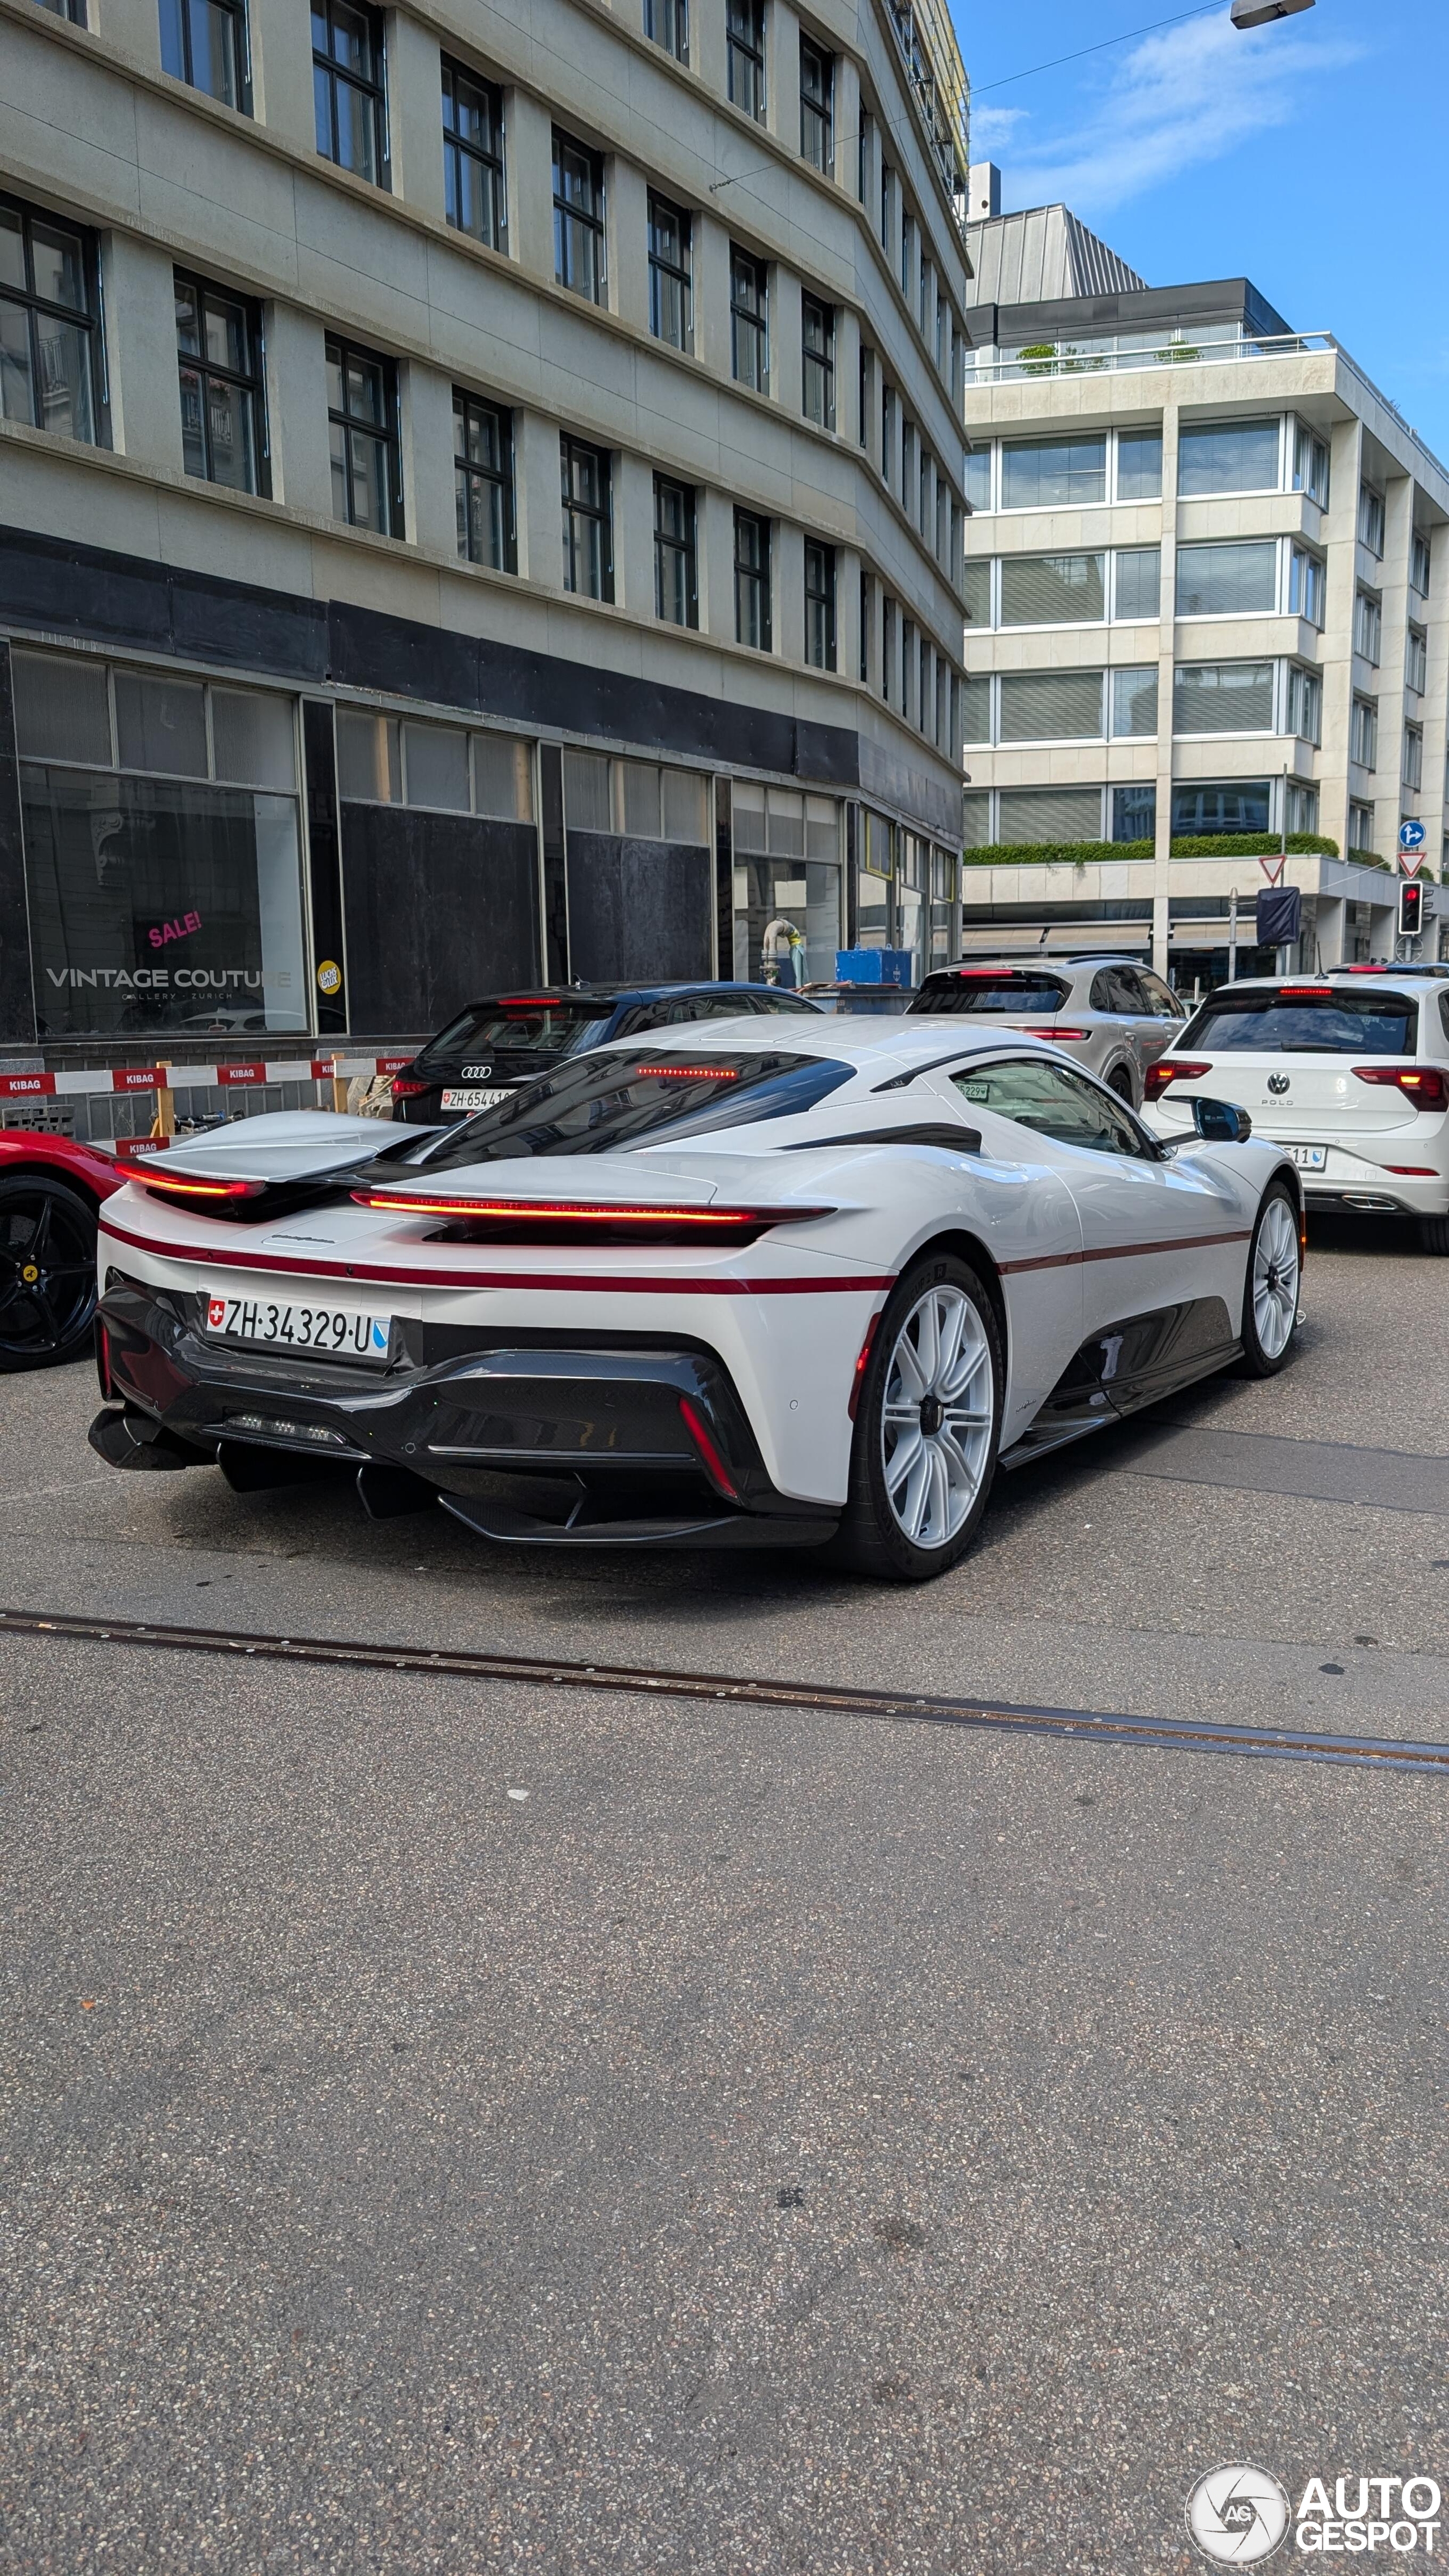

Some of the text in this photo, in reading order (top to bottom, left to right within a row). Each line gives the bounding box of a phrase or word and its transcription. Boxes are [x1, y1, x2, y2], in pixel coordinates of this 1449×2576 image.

[148, 910, 202, 948] SALE!
[46, 968, 291, 988] VINTAGE COUTURE
[229, 1069, 255, 1079] KIBAG
[322, 1065, 335, 1074] KIB
[126, 1074, 154, 1084] KIBAG
[10, 1080, 41, 1090] KIBAG
[130, 1143, 157, 1153] KIBAG
[1284, 1147, 1308, 1164] 11
